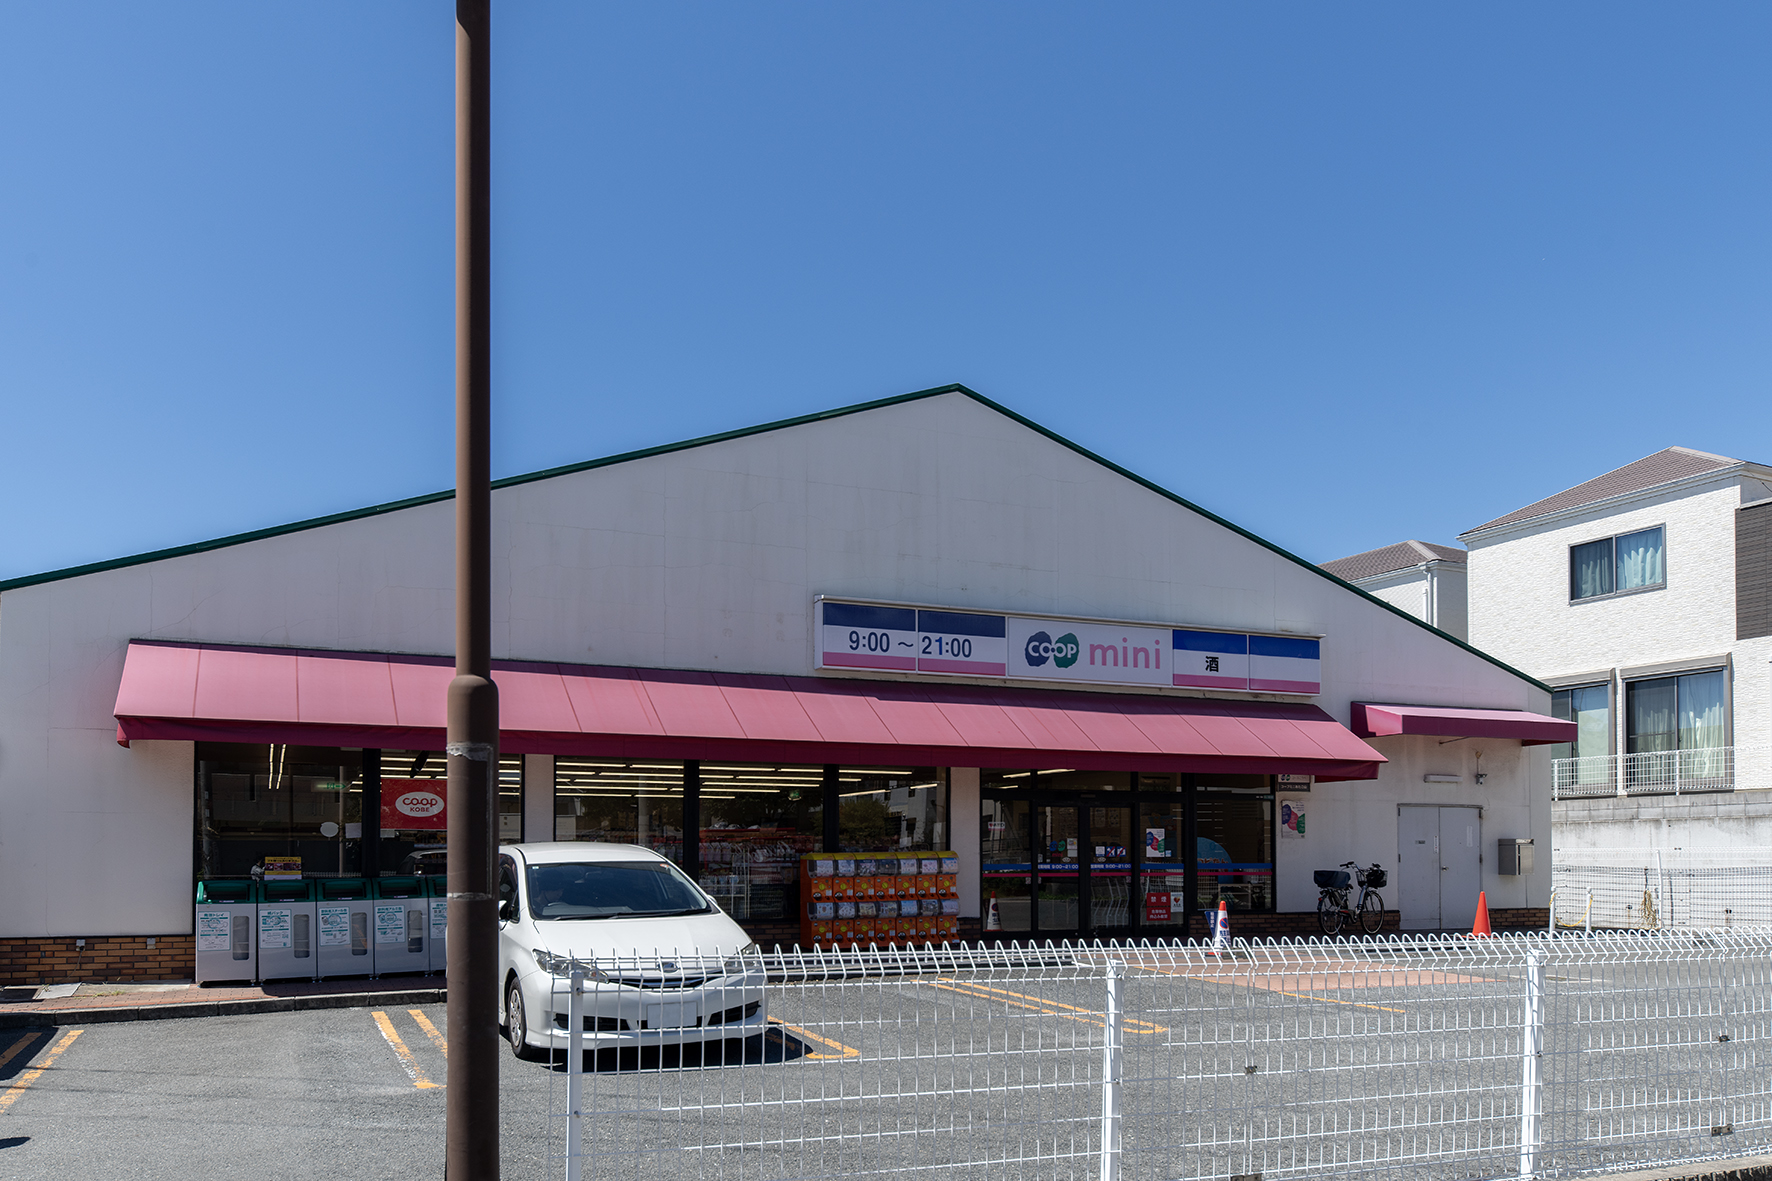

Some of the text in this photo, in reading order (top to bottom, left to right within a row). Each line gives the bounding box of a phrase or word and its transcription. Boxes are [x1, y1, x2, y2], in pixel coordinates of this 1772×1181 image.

[849, 630, 890, 653] 9:00
[922, 636, 972, 658] 21:00
[1089, 637, 1161, 669] mini
[1205, 655, 1220, 673] 酒
